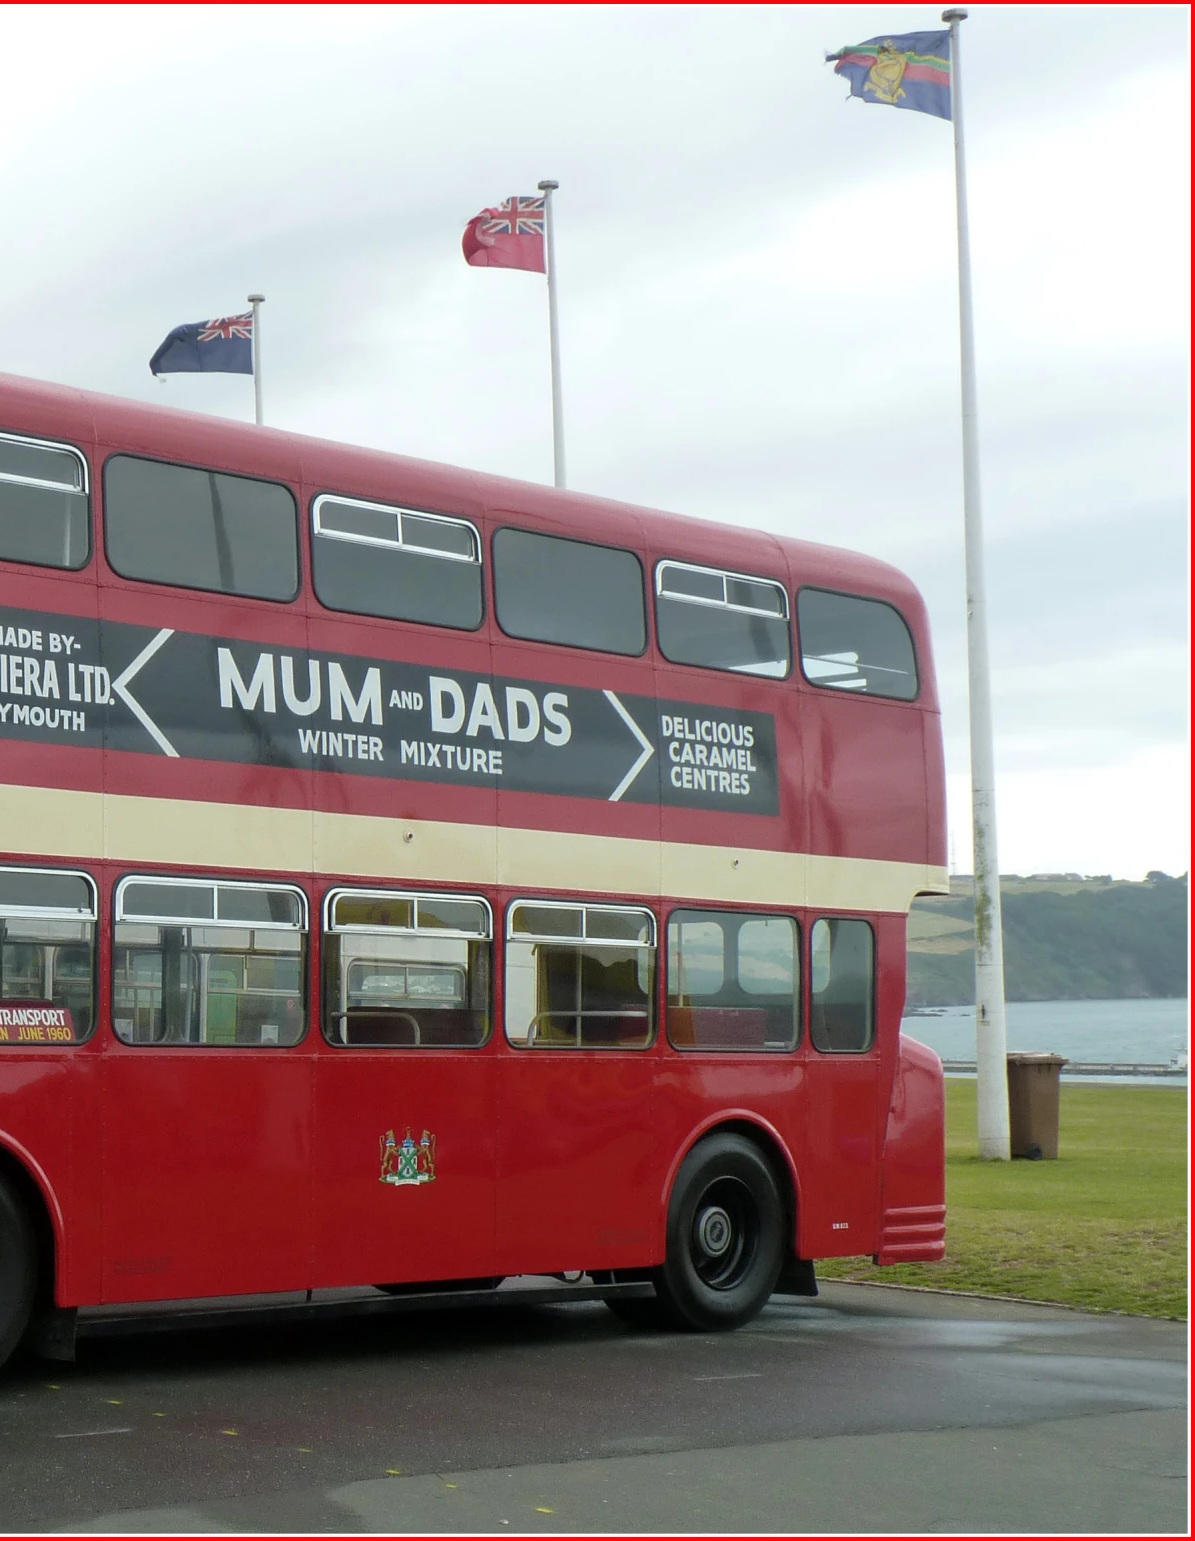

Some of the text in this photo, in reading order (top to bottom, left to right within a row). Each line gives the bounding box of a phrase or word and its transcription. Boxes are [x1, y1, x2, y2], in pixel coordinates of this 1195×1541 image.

[49, 632, 82, 655] BY-
[67, 662, 116, 706] LTD.
[216, 646, 573, 747] MUM AND DADS
[660, 714, 755, 748] DELICIOUS
[298, 728, 504, 775] WINTER MIXTURE
[668, 744, 757, 773] CARAMEL
[670, 766, 752, 796] CENTRES
[17, 1026, 46, 1041] JUNE
[46, 1027, 72, 1041] 1960
